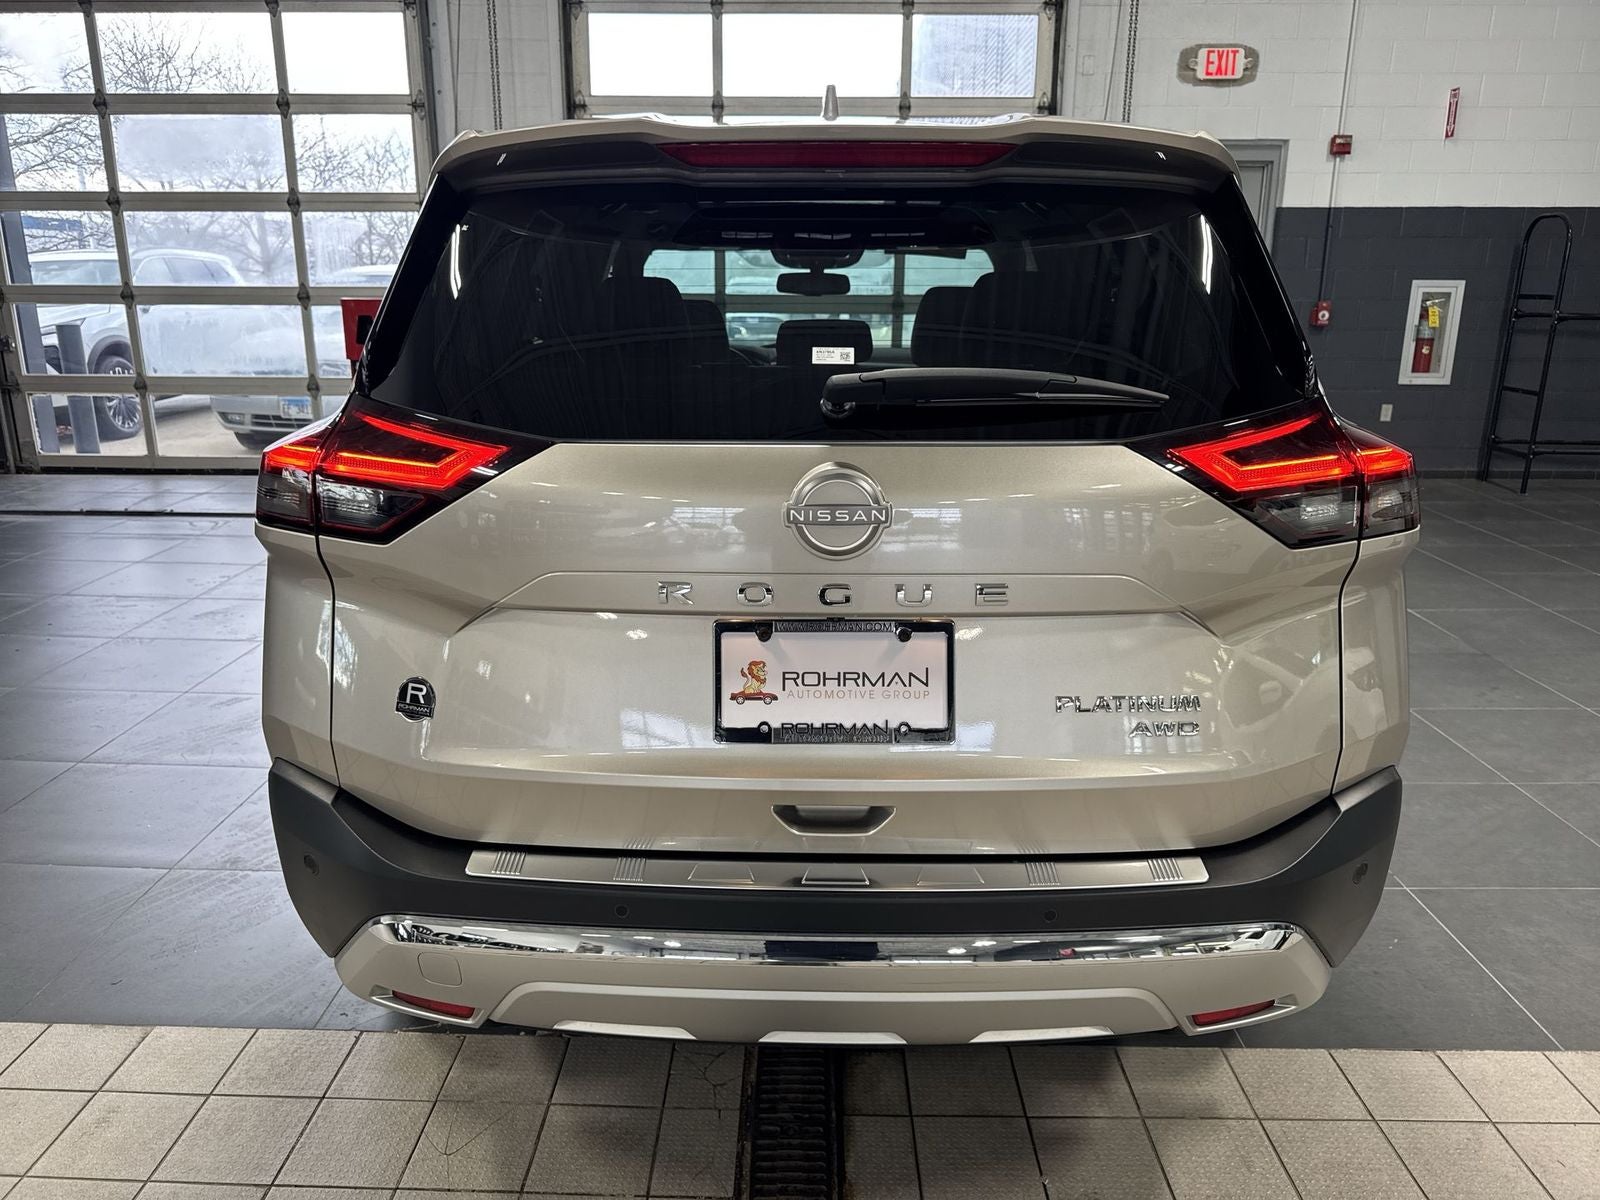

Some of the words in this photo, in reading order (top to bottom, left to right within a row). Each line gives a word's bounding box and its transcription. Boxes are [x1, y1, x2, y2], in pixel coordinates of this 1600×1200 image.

[1205, 49, 1239, 76] EXIT
[790, 509, 886, 522] NISSAN
[657, 580, 1009, 607] ROGUE
[782, 667, 929, 692] ROHRMAN
[406, 682, 427, 704] R
[787, 690, 875, 699] AUTOMOTIVE
[882, 690, 930, 700] GROUP
[1055, 695, 1202, 713] PLATINUM
[781, 720, 889, 737] ROHRMAN
[1128, 721, 1200, 738] AWD
